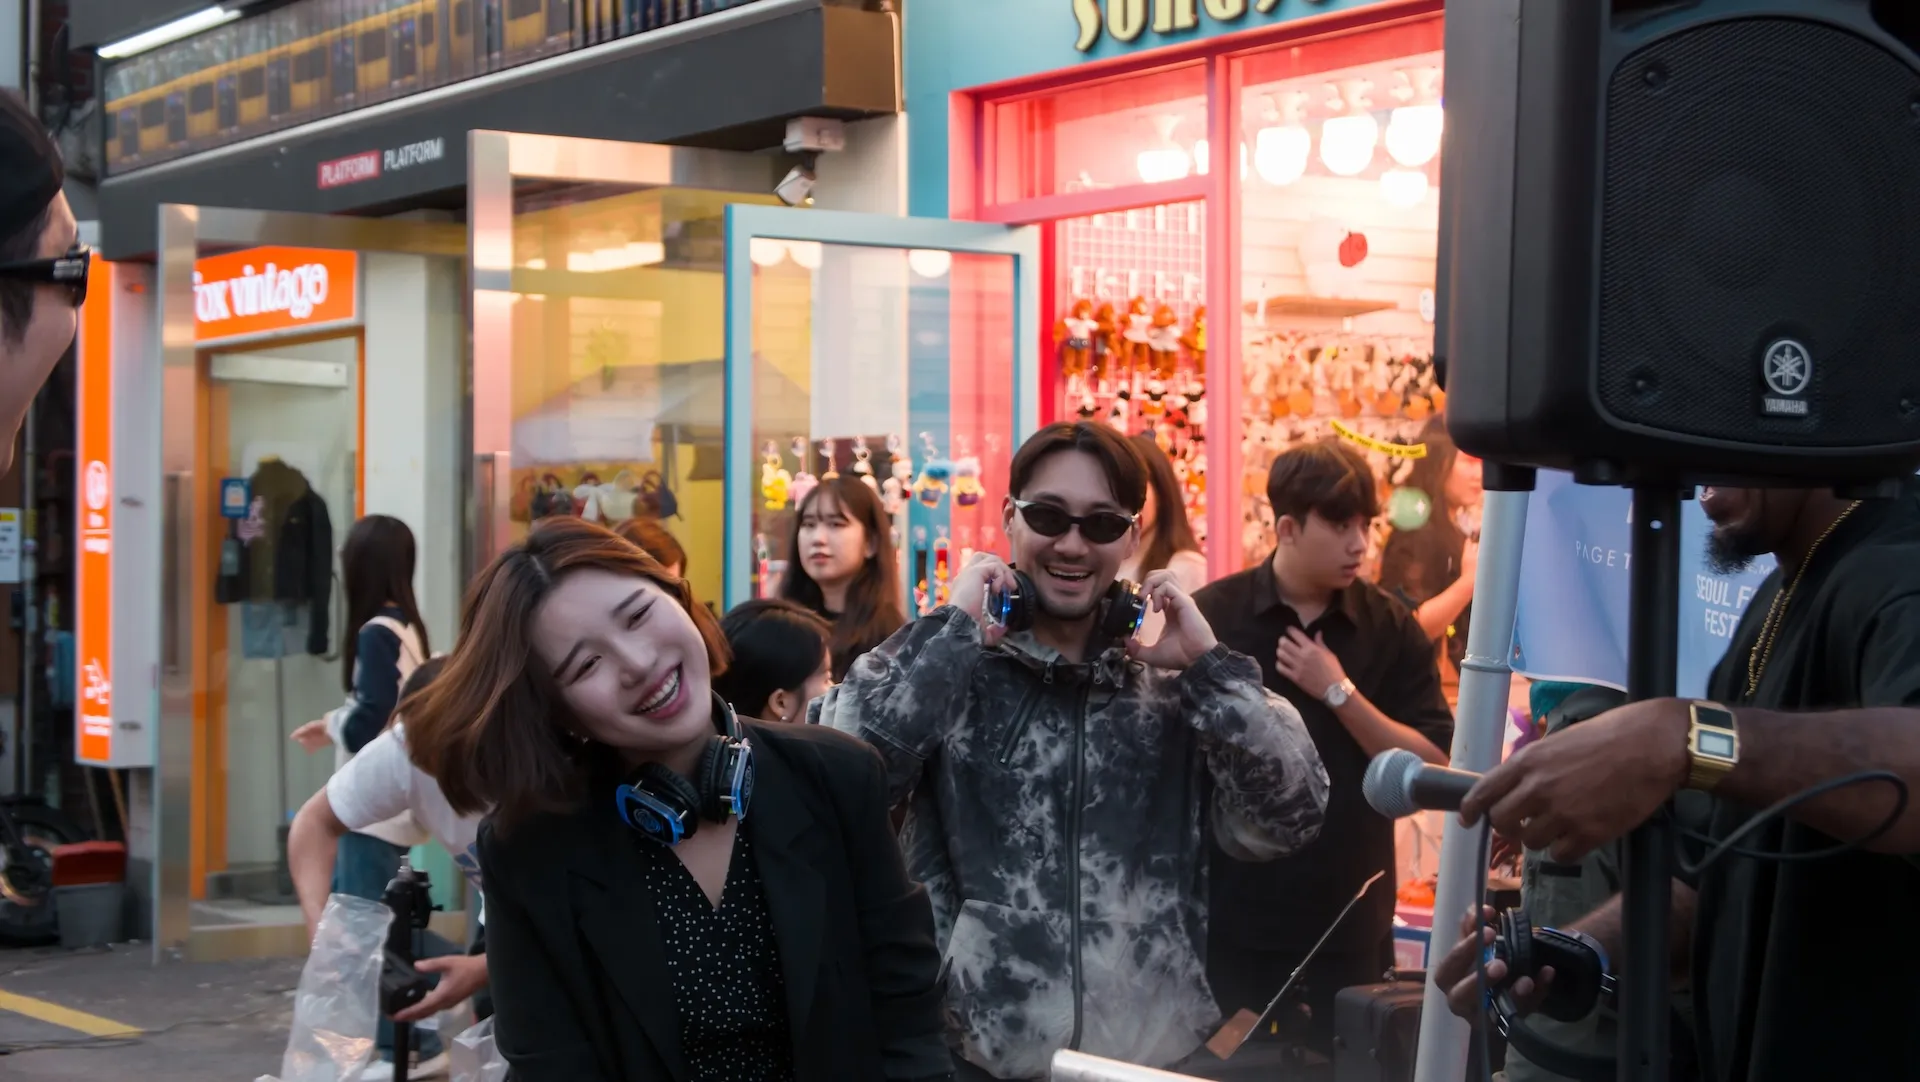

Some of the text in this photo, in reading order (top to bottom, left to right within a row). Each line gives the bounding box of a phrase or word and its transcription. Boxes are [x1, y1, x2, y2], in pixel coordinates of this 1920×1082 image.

[321, 137, 444, 185] PLATFORM PLATFORM
[230, 262, 328, 319] vintage
[1764, 398, 1807, 414] YAMAHA
[1576, 540, 1616, 567] PAGE
[1696, 573, 1732, 608] SEOUL
[1704, 608, 1740, 639] FEST
